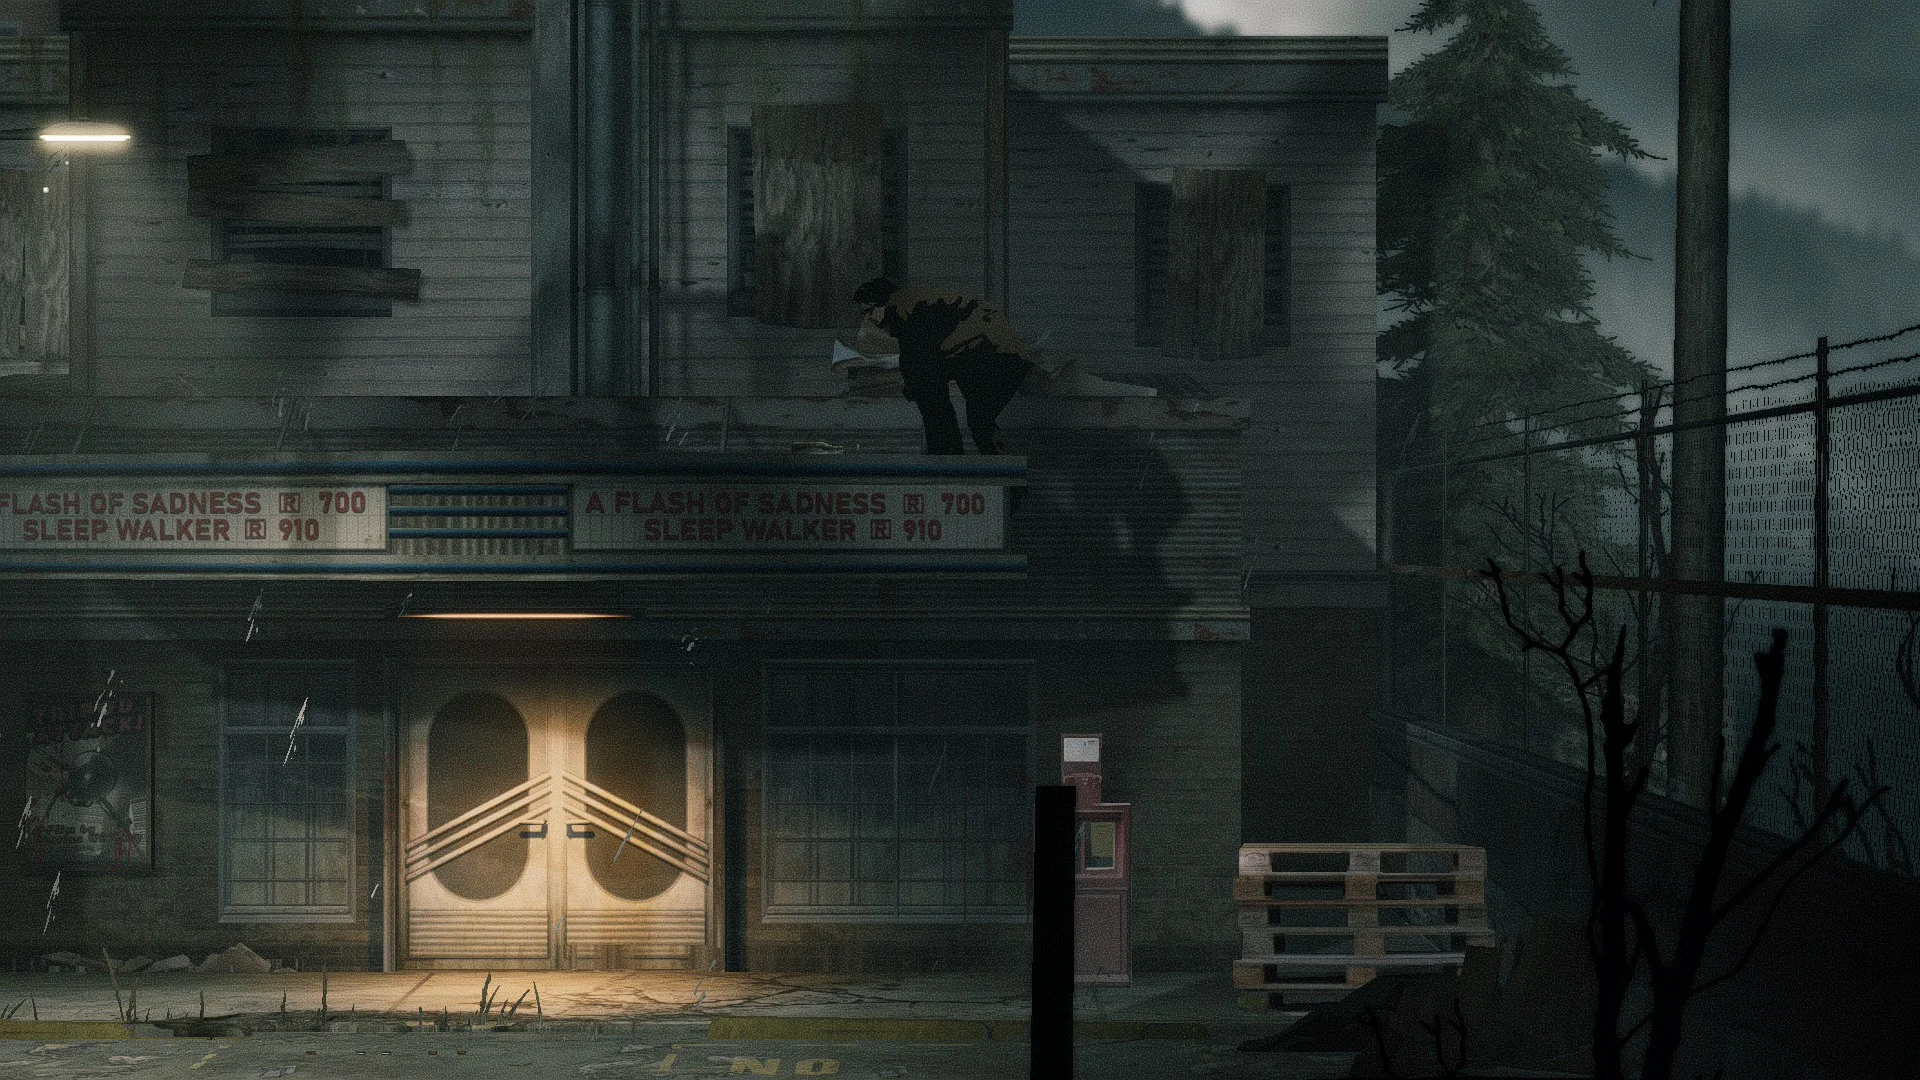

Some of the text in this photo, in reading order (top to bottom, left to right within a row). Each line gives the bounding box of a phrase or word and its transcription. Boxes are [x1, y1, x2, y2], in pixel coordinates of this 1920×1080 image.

[89, 492, 123, 513] OF
[132, 492, 261, 513] SADNESS
[318, 492, 366, 513] 700
[585, 493, 604, 513] A
[614, 493, 704, 513] FLASH
[714, 493, 749, 513] OF
[759, 493, 886, 513] SADNESS
[941, 493, 985, 514] 700
[23, 519, 107, 541] SLEEP
[116, 519, 230, 541] WALKER
[279, 518, 319, 541] 910
[644, 519, 733, 541] SLEEP
[743, 519, 856, 541] WALKER
[904, 519, 942, 541] 910
[728, 1057, 841, 1077] NO
